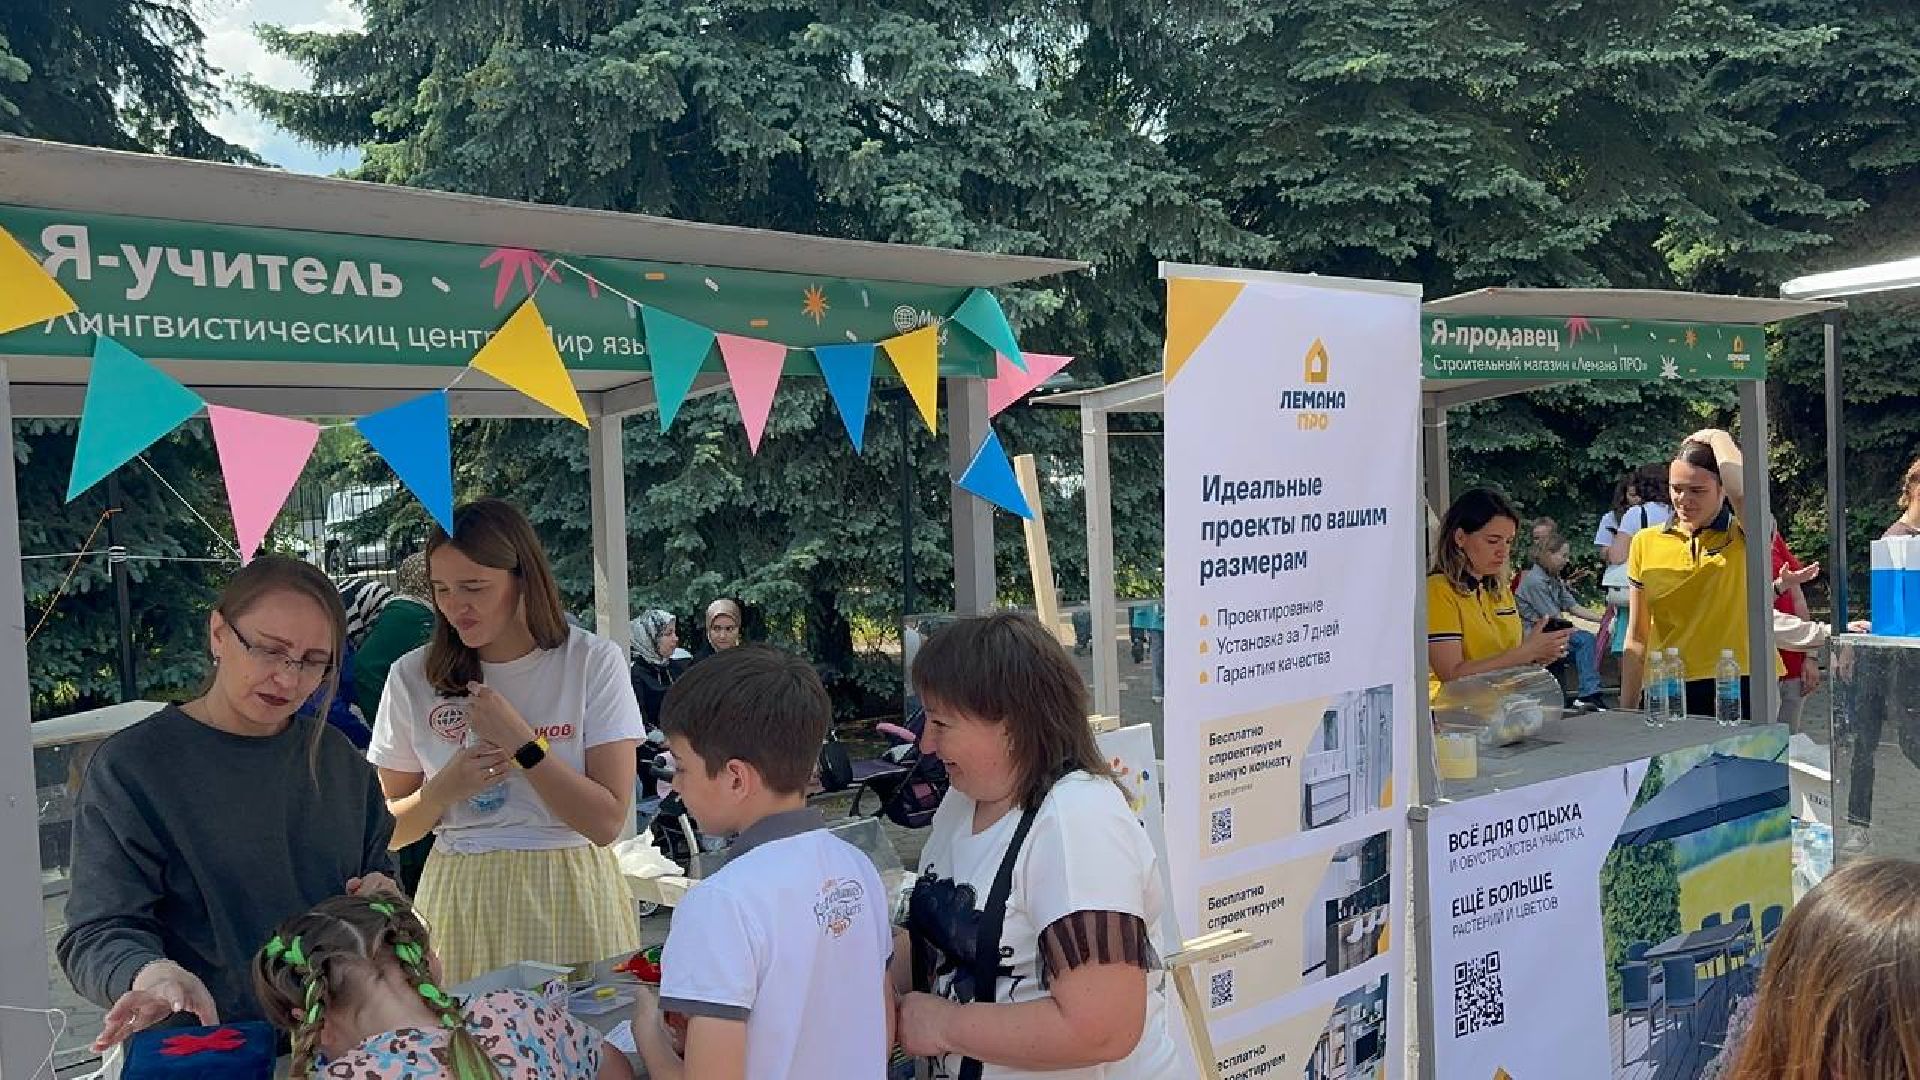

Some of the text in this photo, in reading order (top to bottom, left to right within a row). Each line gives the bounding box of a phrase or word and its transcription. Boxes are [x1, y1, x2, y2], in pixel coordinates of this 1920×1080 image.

[41, 225, 403, 300] Я-учитель
[547, 325, 594, 360] ир
[1431, 319, 1559, 354] Я-продавец
[1433, 355, 1521, 375] Строительный
[1523, 359, 1570, 372] магазин
[1280, 390, 1346, 409] ЛЕМАНА
[1297, 413, 1329, 430] ПРО
[1202, 474, 1323, 505] Идеальные
[1201, 507, 1387, 547] проекты по вашим
[1200, 550, 1307, 586] размерам
[1217, 599, 1324, 630] Проектирование
[1216, 619, 1340, 655] Установка за 7 дней
[1217, 651, 1331, 685] Гарантия качества
[1209, 726, 1264, 746] Бесплатно
[1209, 738, 1282, 765] спроектируем
[1209, 755, 1291, 783] ванную комнату
[1449, 803, 1583, 852] ВСЁ ДЛЯ ОТДЫХА
[1450, 826, 1585, 873] И ОБУСТРОЙСТВА УЧАСТКА
[1208, 885, 1265, 911] Бесплатно
[1452, 872, 1554, 918] ЕЩЁ БОЛЬШЕ
[1208, 896, 1285, 929] спроектируем
[1452, 896, 1559, 938] РАСТЕНИЙ И ЦВЕТОВ
[1217, 1044, 1267, 1072] есплатно
